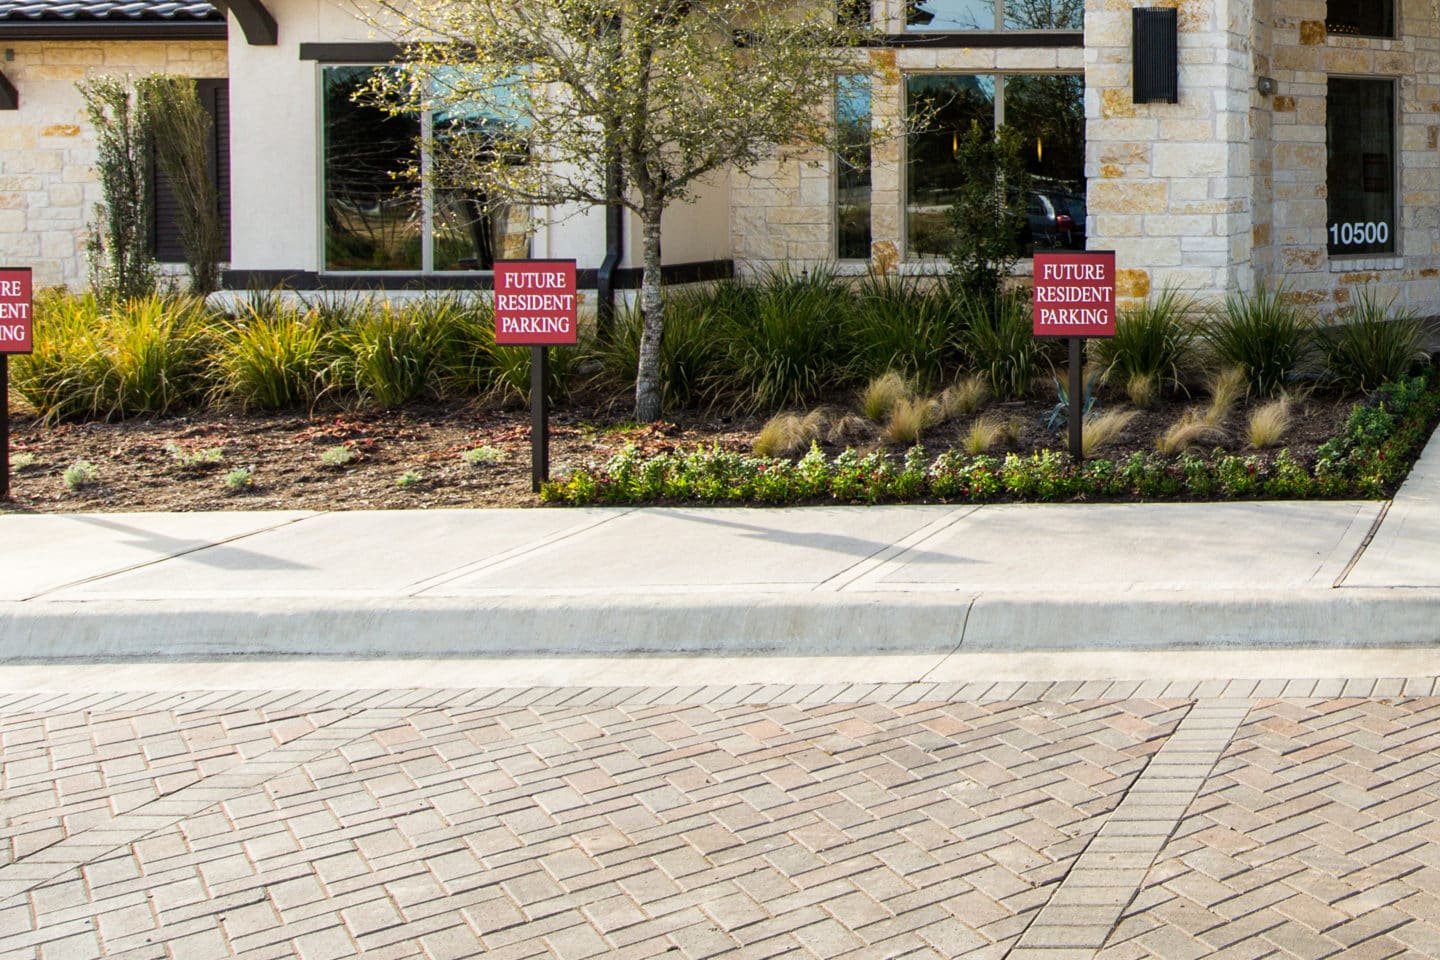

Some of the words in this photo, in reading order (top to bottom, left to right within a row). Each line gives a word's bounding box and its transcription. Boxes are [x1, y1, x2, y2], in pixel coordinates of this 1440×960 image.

[1329, 221, 1389, 246] 10500
[504, 272, 566, 288] FUTURE
[1043, 263, 1105, 280] FUTURE
[0, 280, 22, 297] RE
[1036, 286, 1113, 302] RESIDENT
[497, 294, 574, 311] RESIDENT
[501, 317, 570, 333] PARKING
[1040, 308, 1108, 325] PARKING
